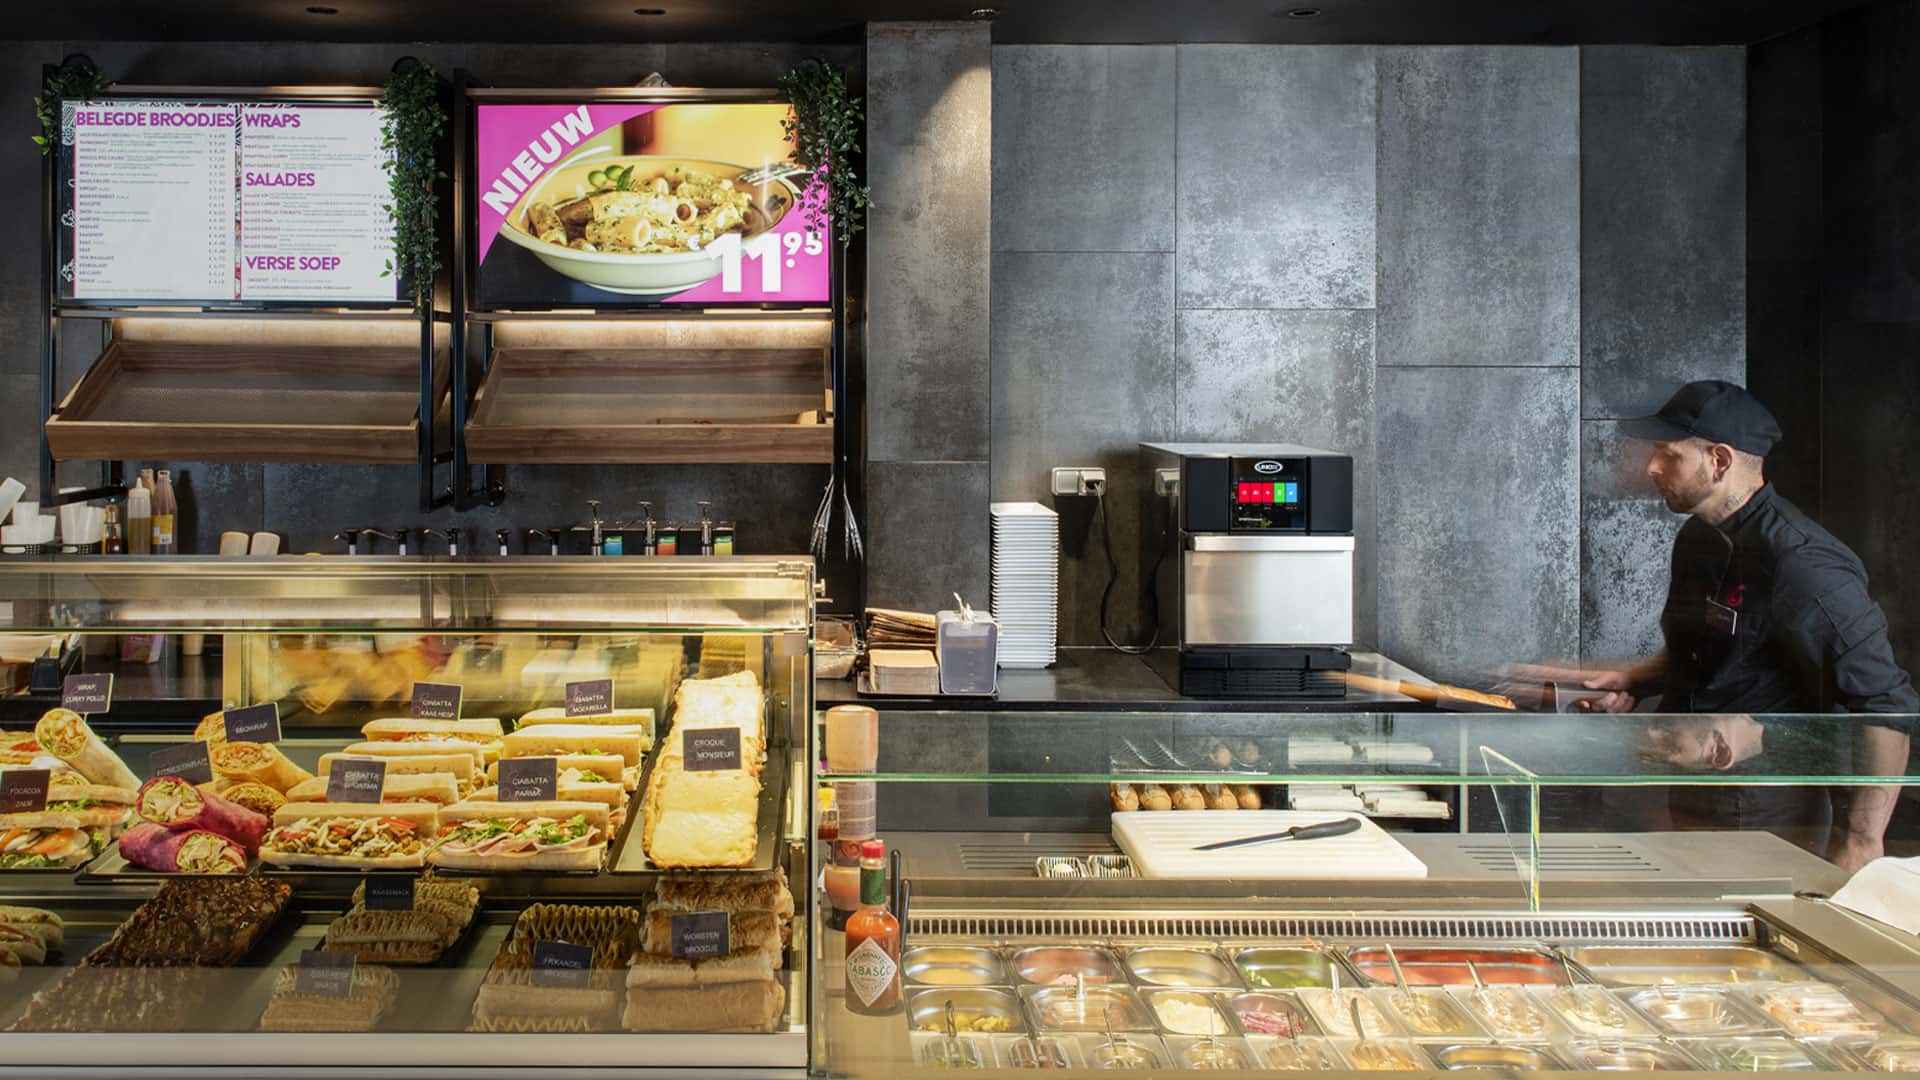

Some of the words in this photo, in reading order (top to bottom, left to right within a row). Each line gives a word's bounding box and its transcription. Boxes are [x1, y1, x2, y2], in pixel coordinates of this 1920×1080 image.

[76, 112, 146, 127] BELEGDE
[150, 112, 235, 128] BROODJES
[245, 113, 301, 128] WRAPS
[482, 104, 597, 216] NIEUW
[245, 172, 316, 187] SALADES
[245, 256, 295, 270] VERSE
[299, 256, 341, 270] SOEP
[694, 738, 726, 747] CROQUE
[695, 751, 736, 760] MONSIEUR
[512, 776, 548, 786] CIABATTA
[513, 787, 542, 798] PARMA
[848, 962, 892, 978] TABASCO
